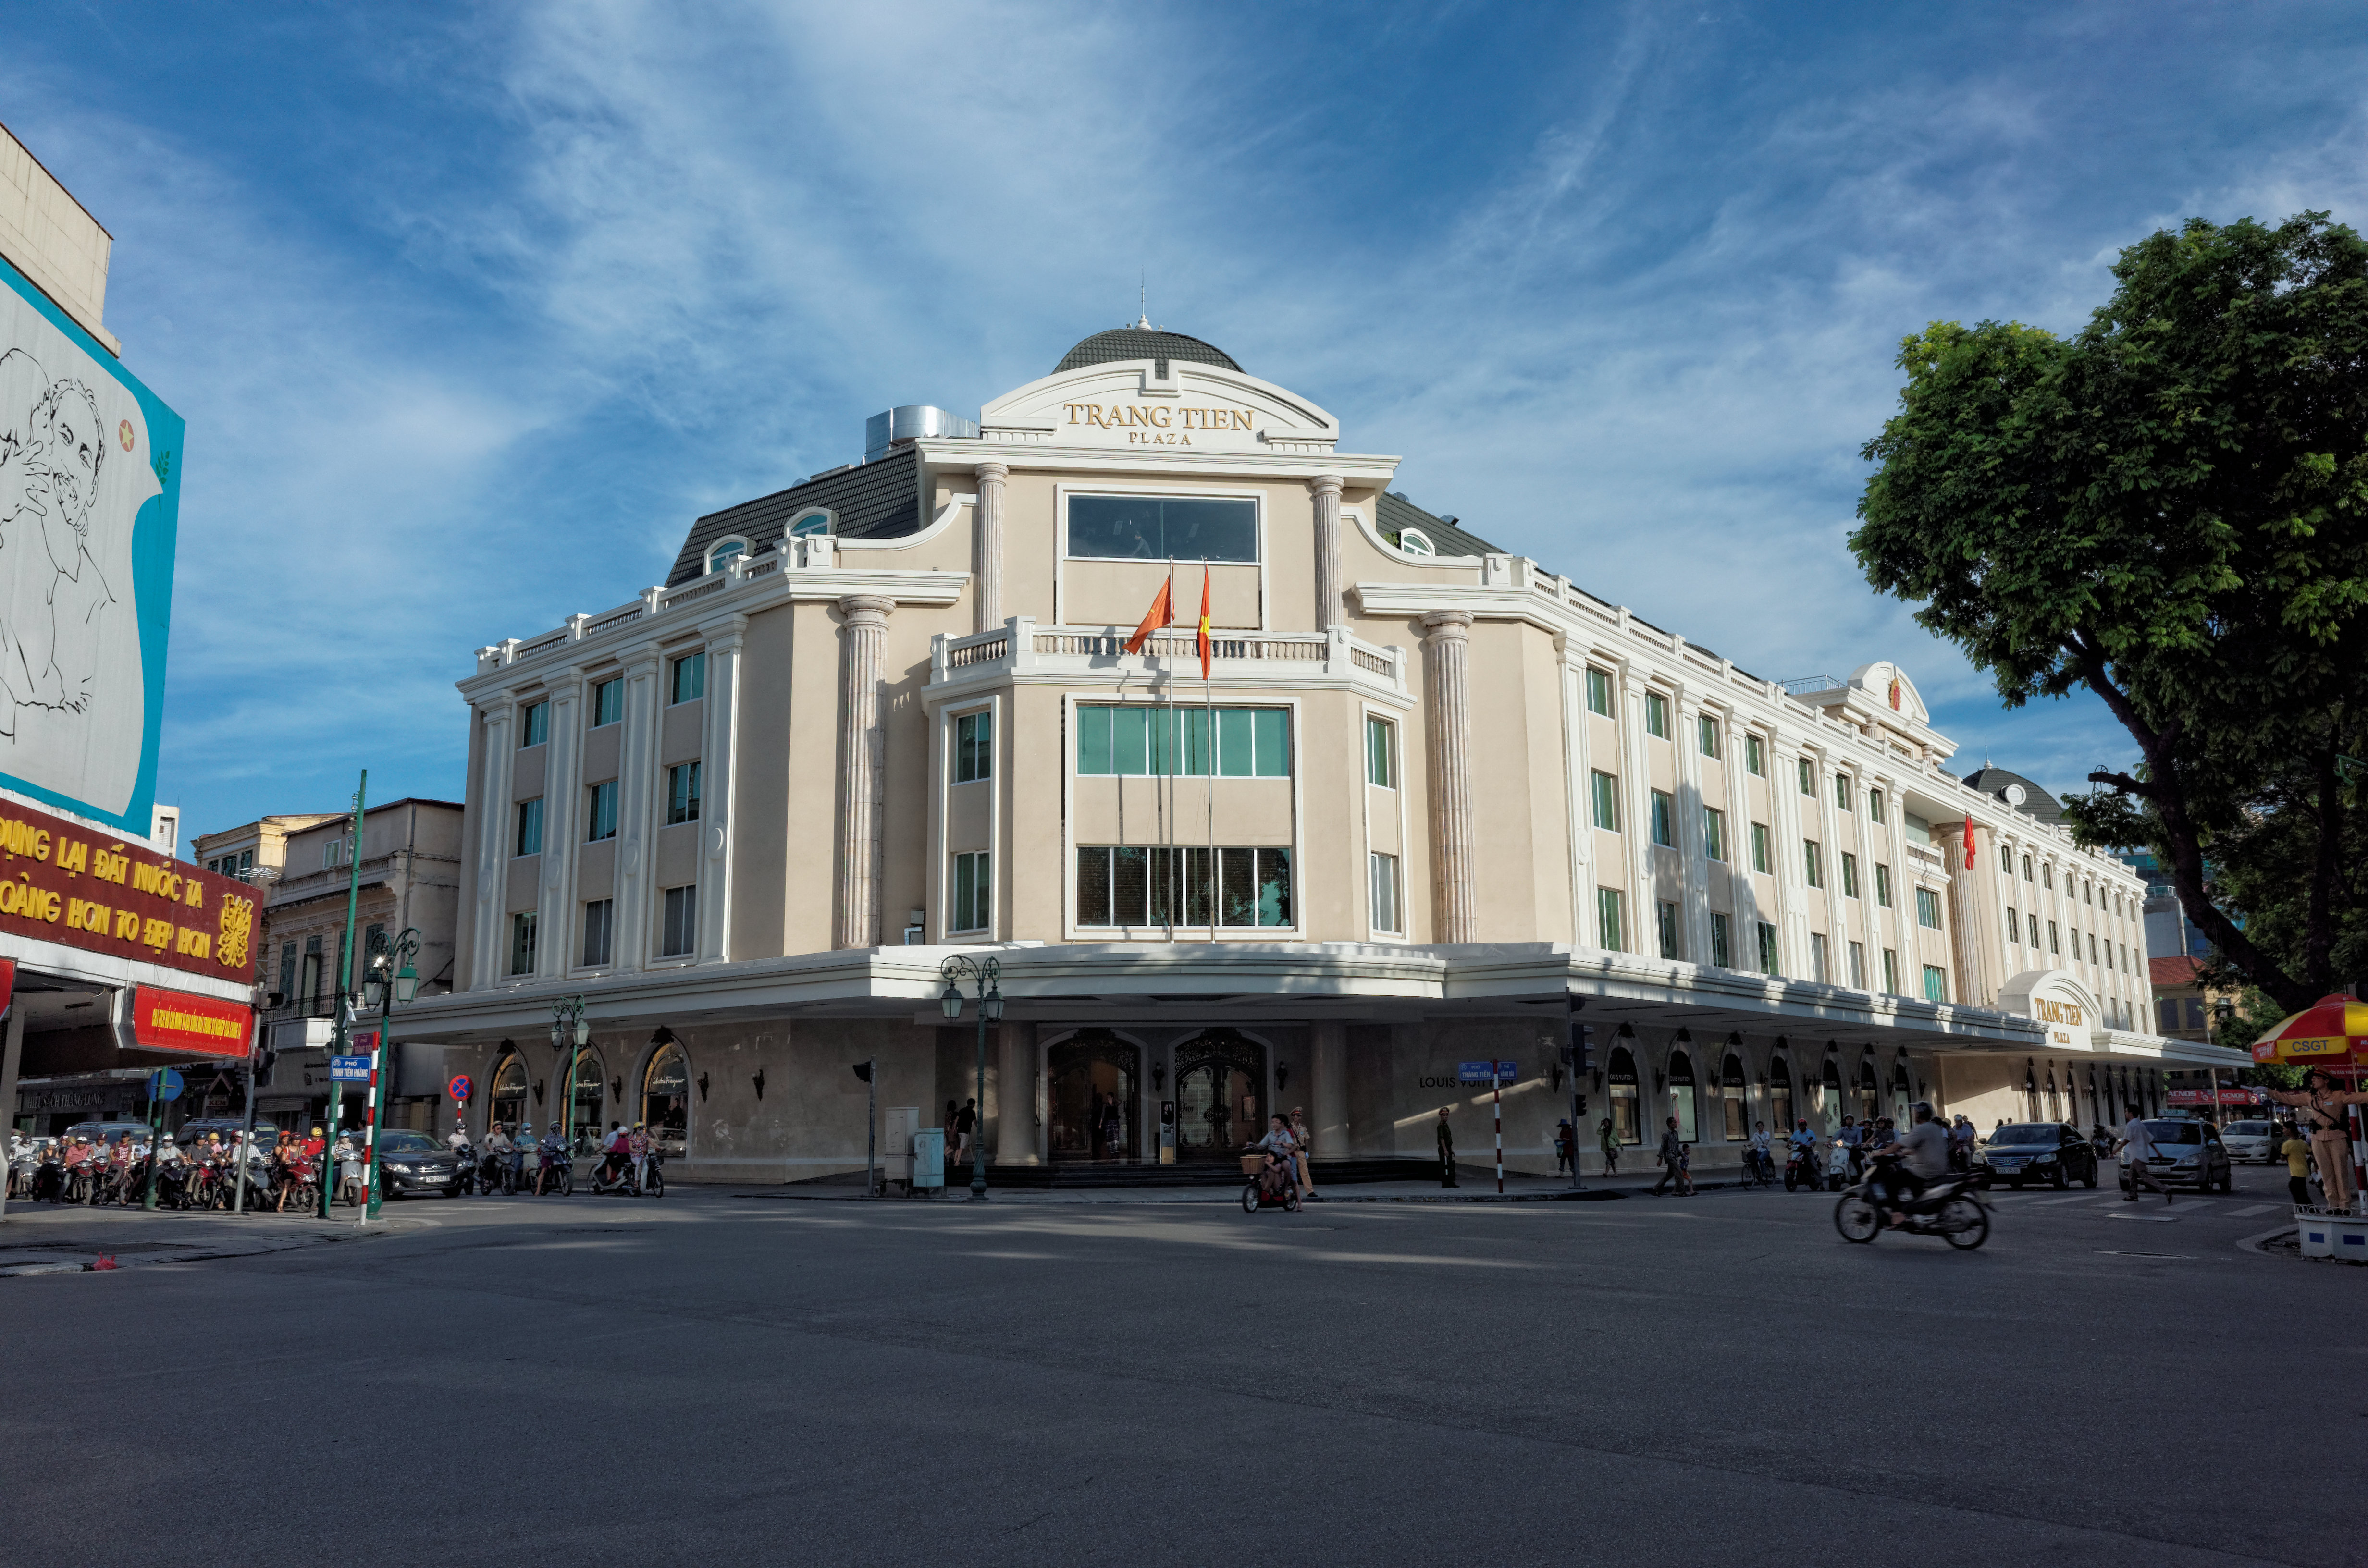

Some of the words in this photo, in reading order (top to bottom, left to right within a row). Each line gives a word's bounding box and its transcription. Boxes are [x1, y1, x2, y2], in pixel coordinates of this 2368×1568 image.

[1063, 403, 1172, 429] TRANG
[1179, 407, 1255, 430] TIEN
[1129, 432, 1192, 445] PLAZA
[56, 837, 88, 878] LẠI
[94, 843, 130, 884] ĐẤT
[185, 878, 202, 909] TA
[116, 910, 139, 941] TO
[143, 918, 174, 955] ĐẸP
[2035, 997, 2063, 1024] TRANG
[2063, 1003, 2082, 1026] TIEN
[2054, 1031, 2070, 1044] PLAZA
[2293, 1040, 2329, 1052] CSGT
[333, 1068, 344, 1077] ĐINH
[344, 1066, 353, 1077] TIÊN
[354, 1066, 368, 1077] HOÀNG
[1420, 1077, 1455, 1088] LOUIS
